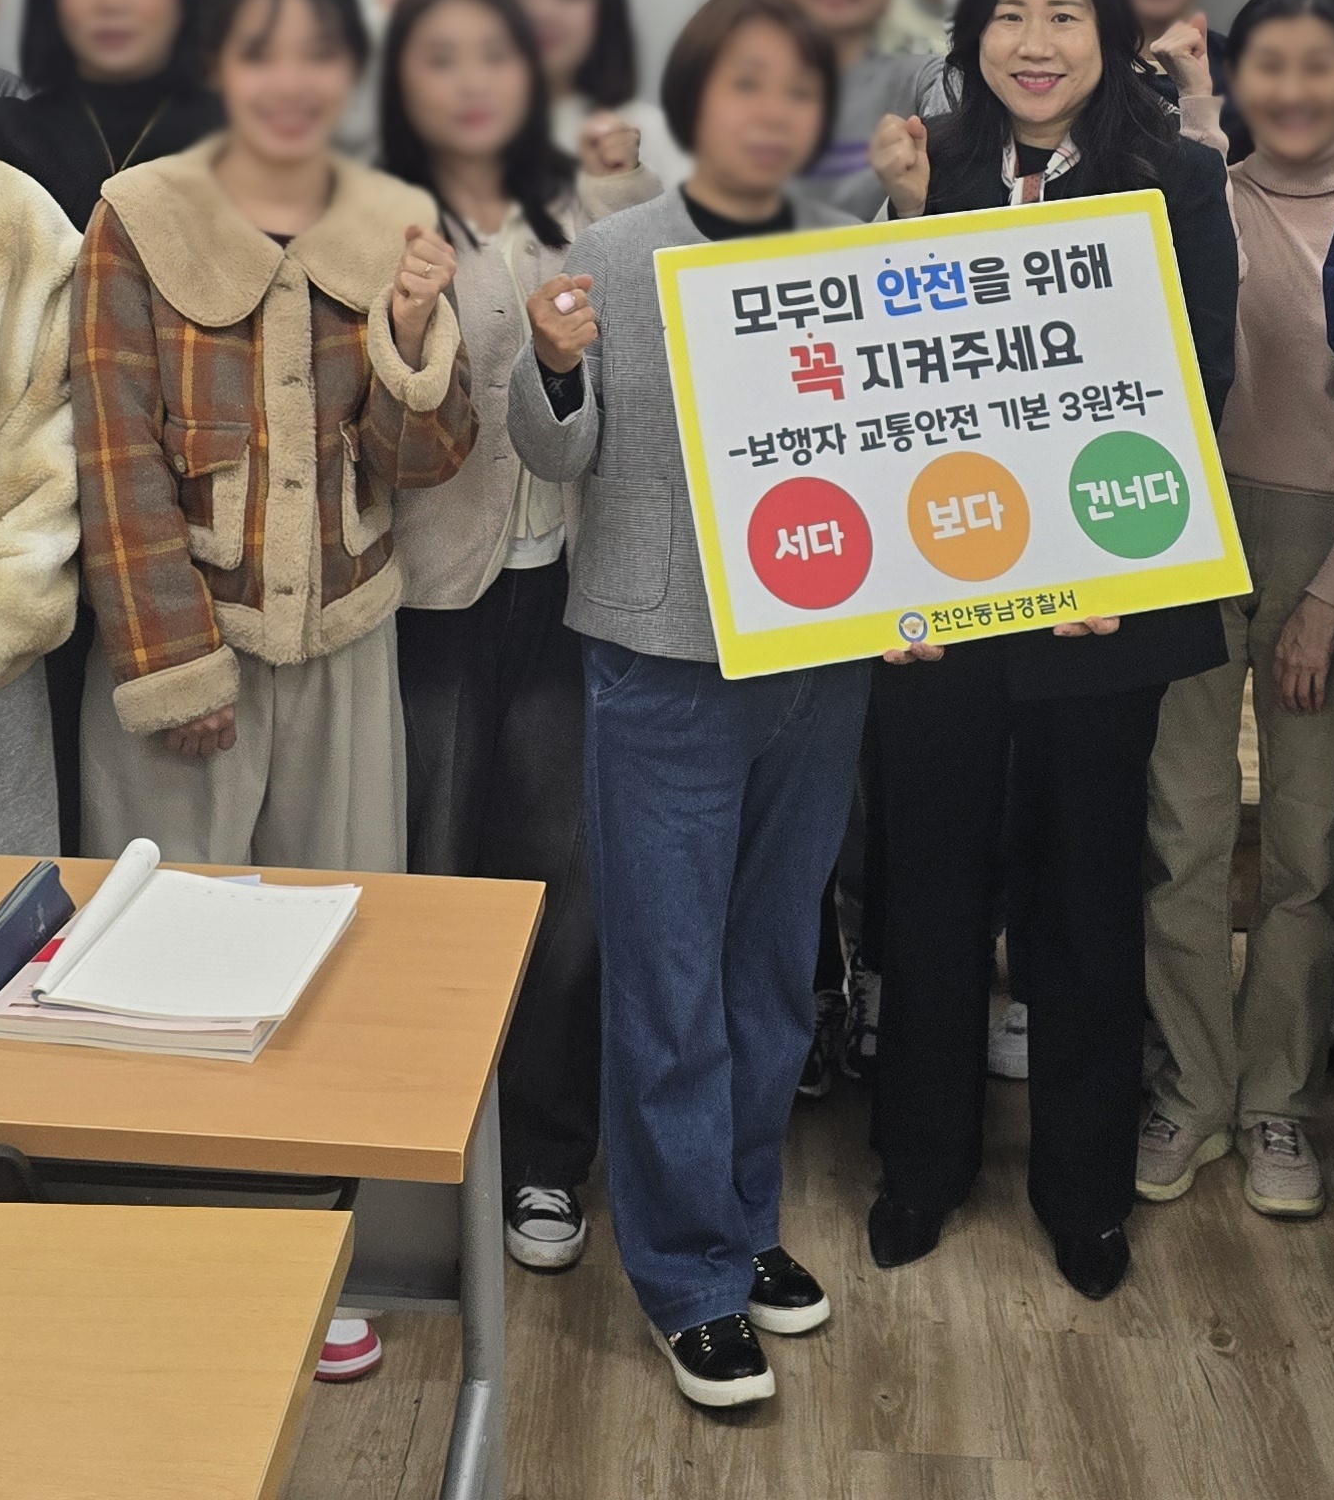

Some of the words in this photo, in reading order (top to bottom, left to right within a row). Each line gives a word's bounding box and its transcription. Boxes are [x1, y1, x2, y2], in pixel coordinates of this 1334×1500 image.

[732, 274, 864, 335] 모두의
[876, 254, 1012, 317] 안전을
[1023, 243, 1113, 296] 위해
[790, 339, 846, 401] 꼭
[856, 320, 1083, 391] 지켜주세요
[728, 422, 847, 467] -보행자
[855, 404, 982, 453] 교통안전
[988, 393, 1051, 432] 기본
[1058, 380, 1164, 423] 3원칙-
[775, 520, 845, 561] 서다
[927, 491, 1004, 540] 보다
[1075, 470, 1180, 521] 건너다
[931, 590, 1078, 633] 천안동남경찰서
